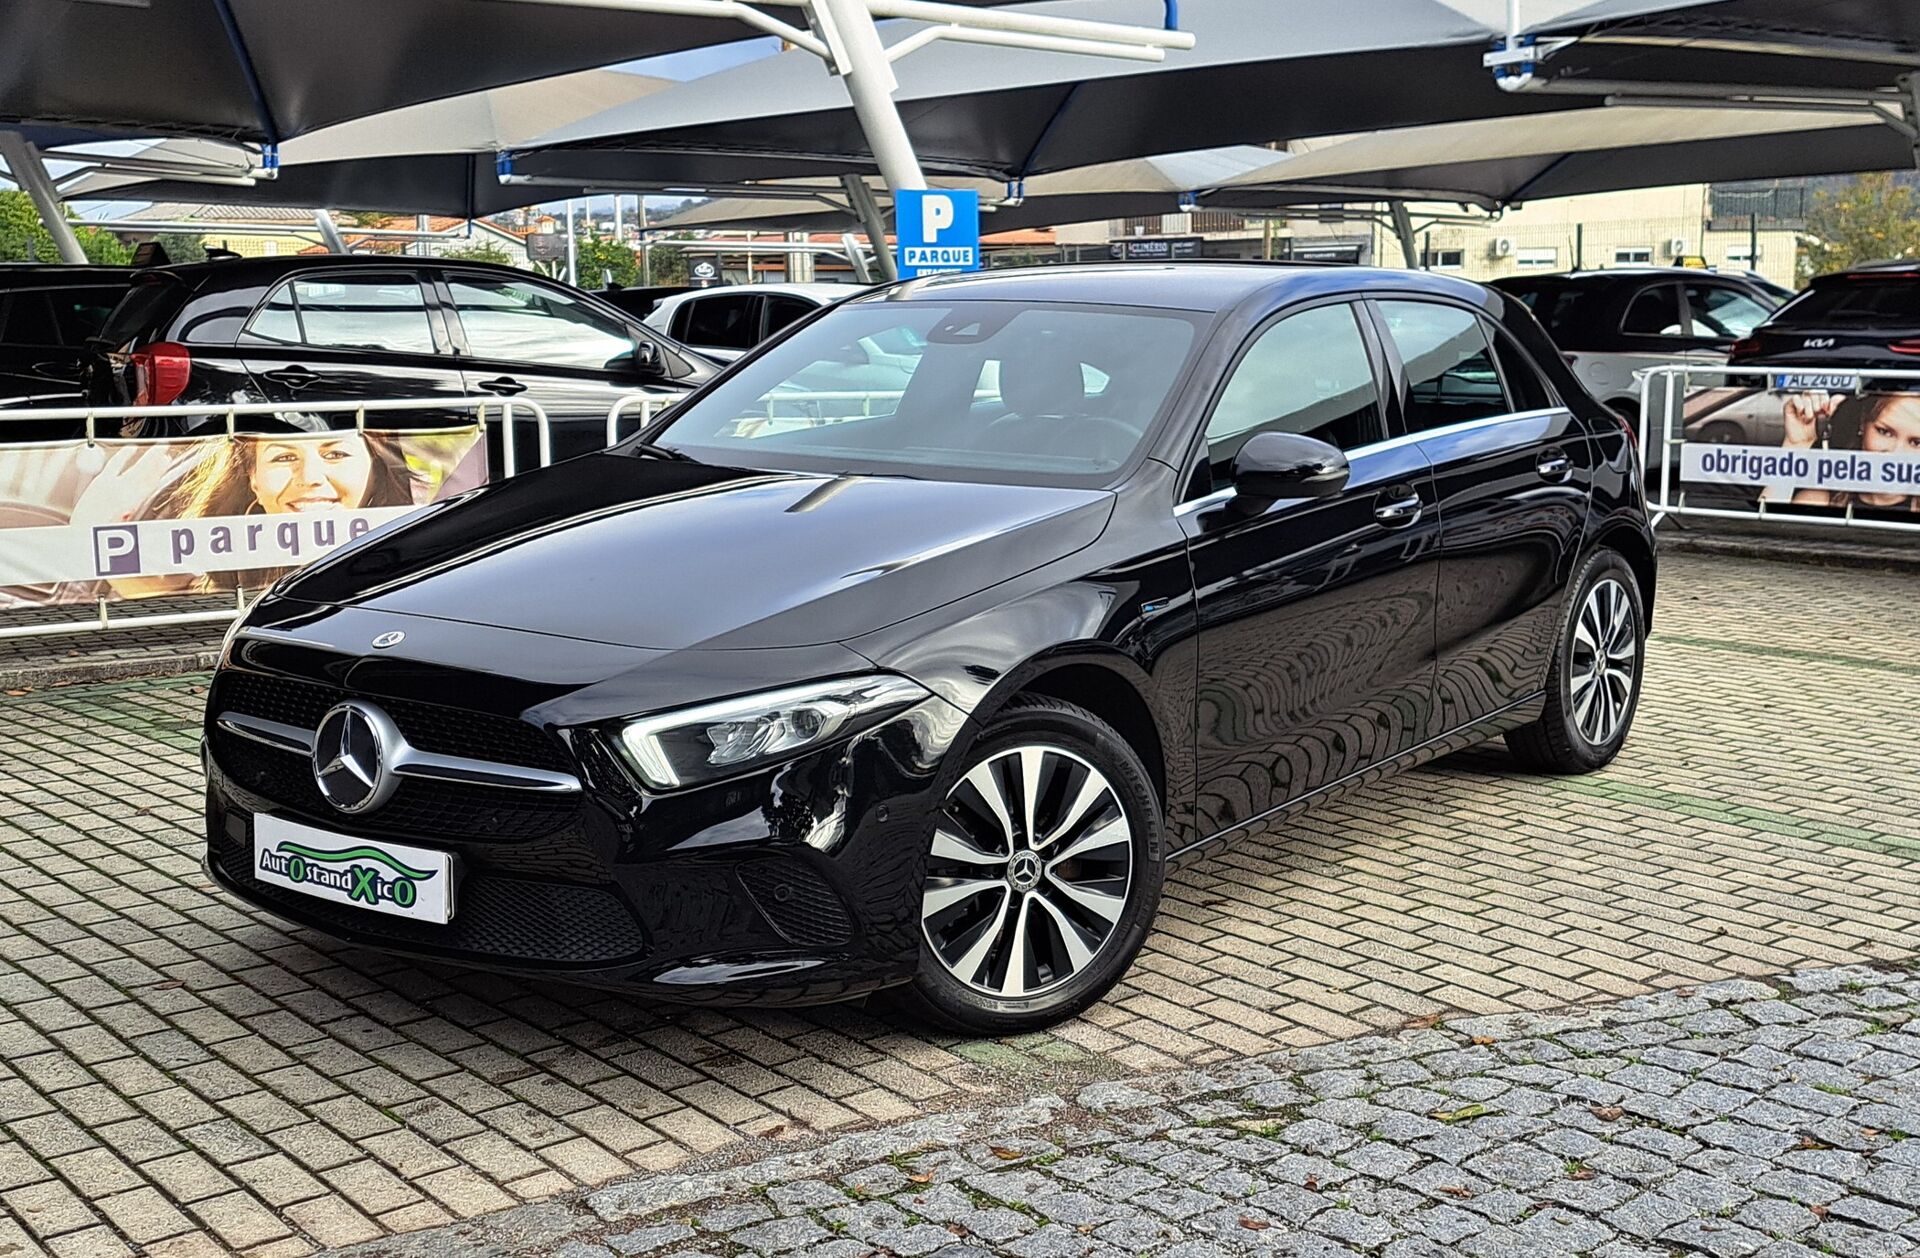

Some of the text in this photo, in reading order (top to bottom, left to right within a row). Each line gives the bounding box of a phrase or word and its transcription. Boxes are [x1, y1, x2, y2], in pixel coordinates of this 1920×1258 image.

[922, 194, 954, 244] P
[907, 249, 971, 263] PARQUE
[1701, 448, 1809, 481] obrigado
[1817, 455, 1872, 485] pela
[171, 516, 370, 565] parque
